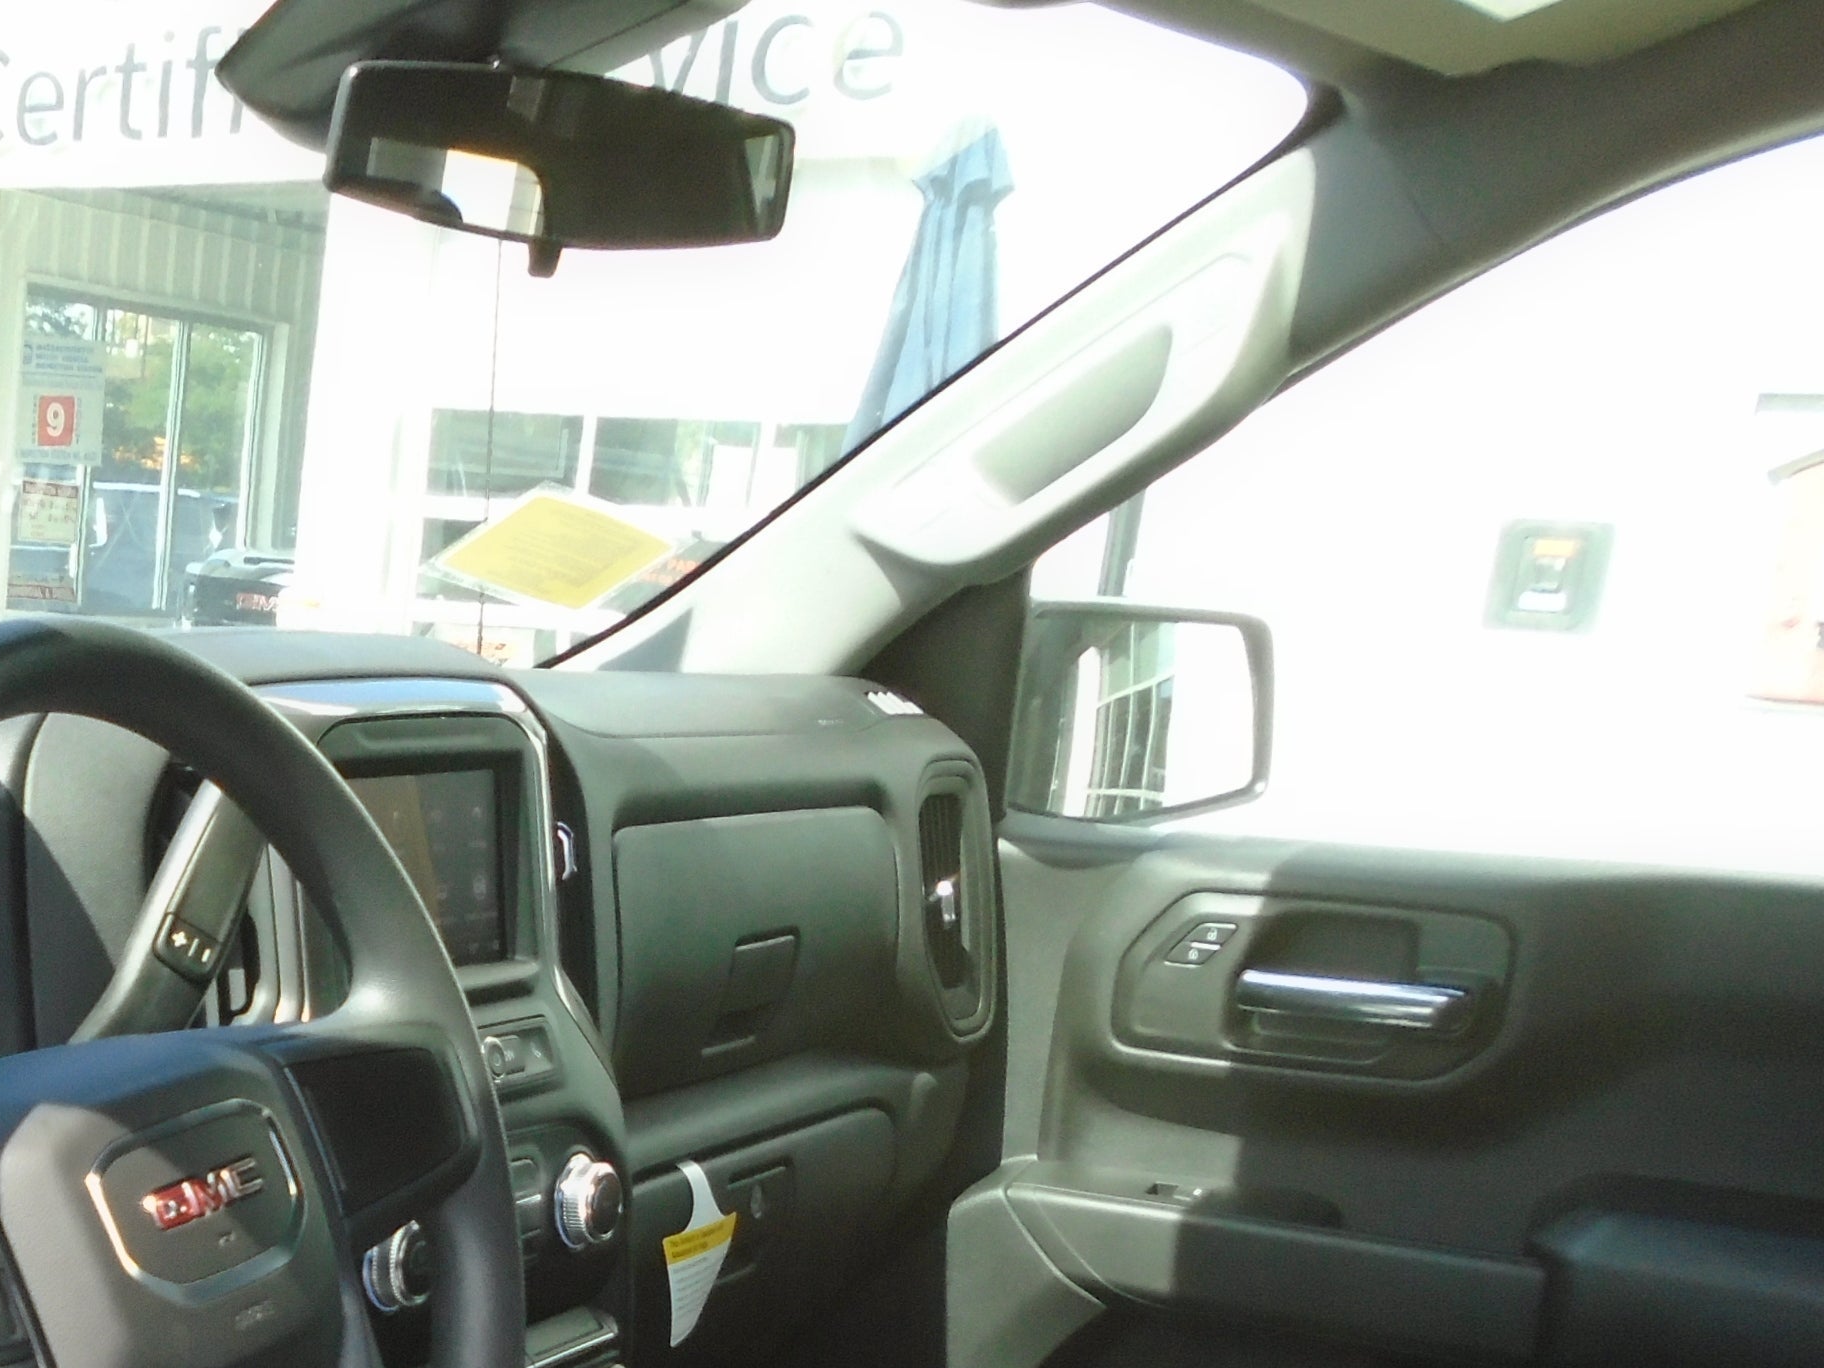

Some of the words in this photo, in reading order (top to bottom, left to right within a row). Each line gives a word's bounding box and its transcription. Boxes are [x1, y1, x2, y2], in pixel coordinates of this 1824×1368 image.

[646, 9, 905, 108] vice
[46, 401, 65, 437] 9
[236, 592, 278, 613] GM
[140, 1156, 264, 1232] GMC
